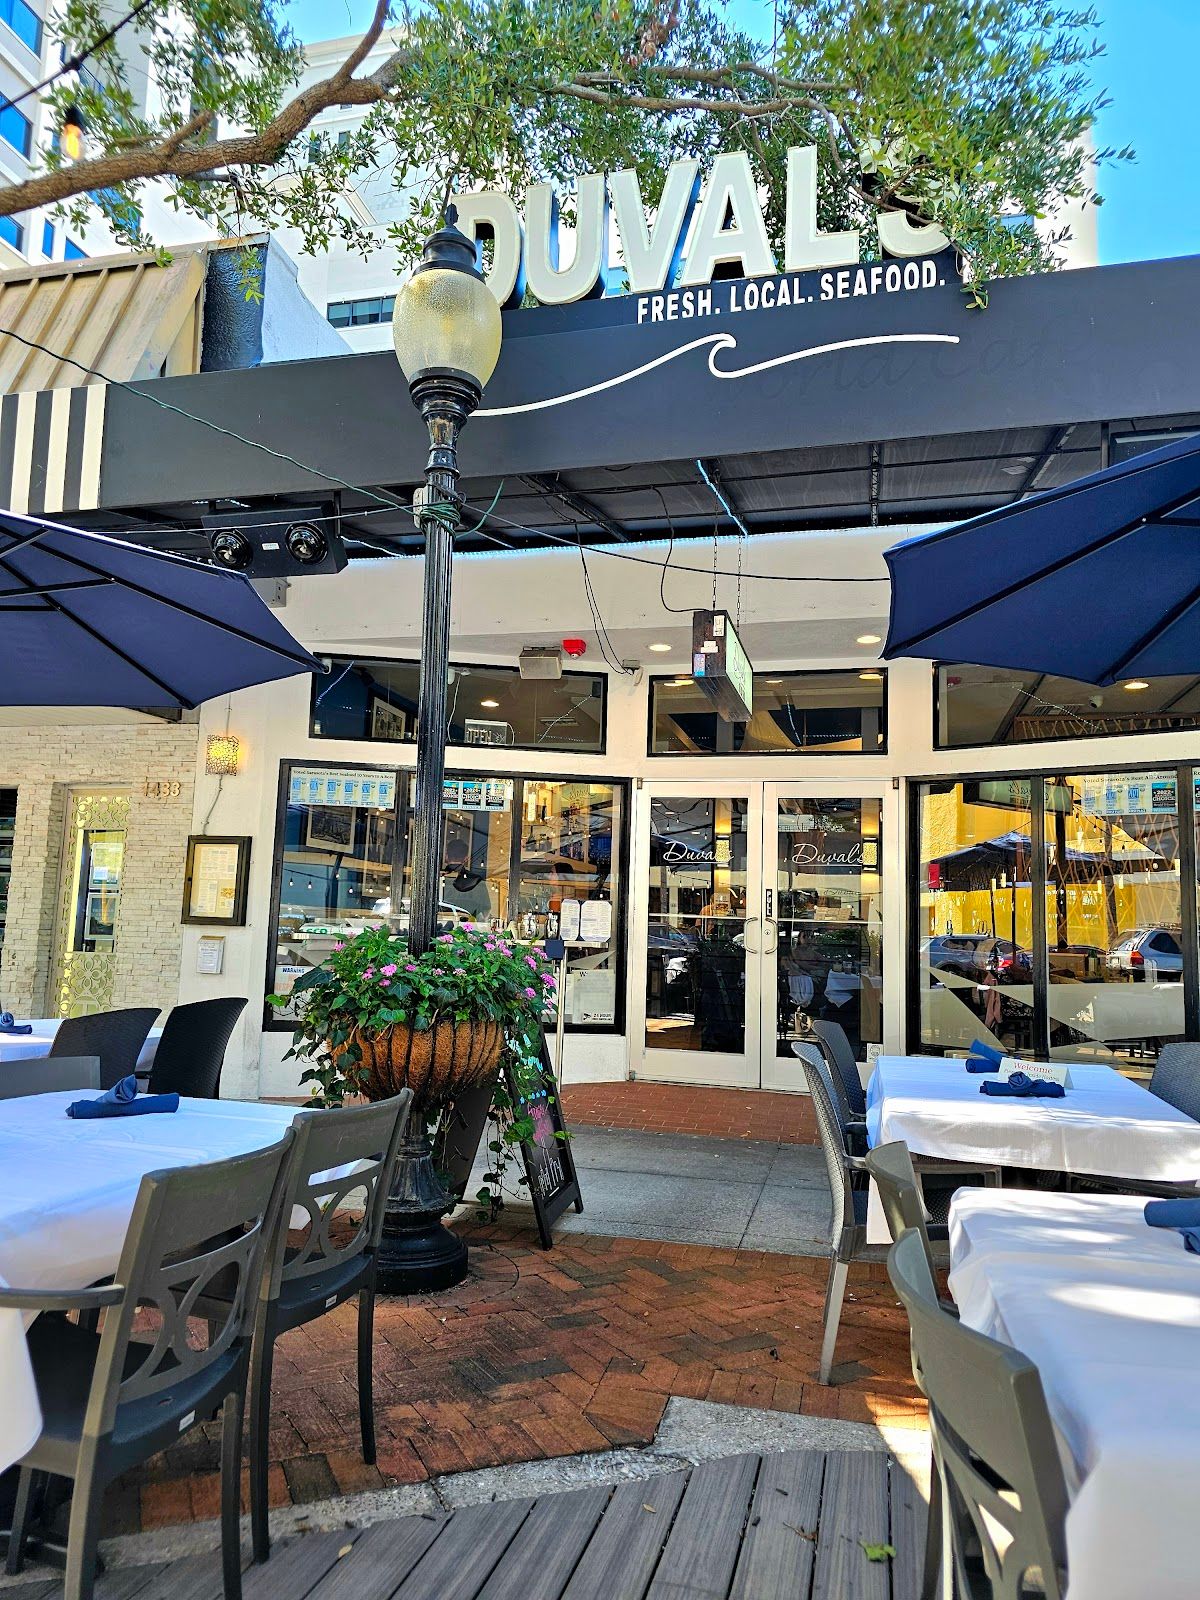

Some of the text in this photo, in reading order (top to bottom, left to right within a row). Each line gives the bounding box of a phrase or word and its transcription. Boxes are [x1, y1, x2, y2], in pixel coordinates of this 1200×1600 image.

[637, 260, 946, 324] FRESH. LOCAL. SEAFOOD.
[466, 728, 492, 745] OPEN
[142, 781, 181, 798] 1433
[1014, 1061, 1053, 1075] Welcome
